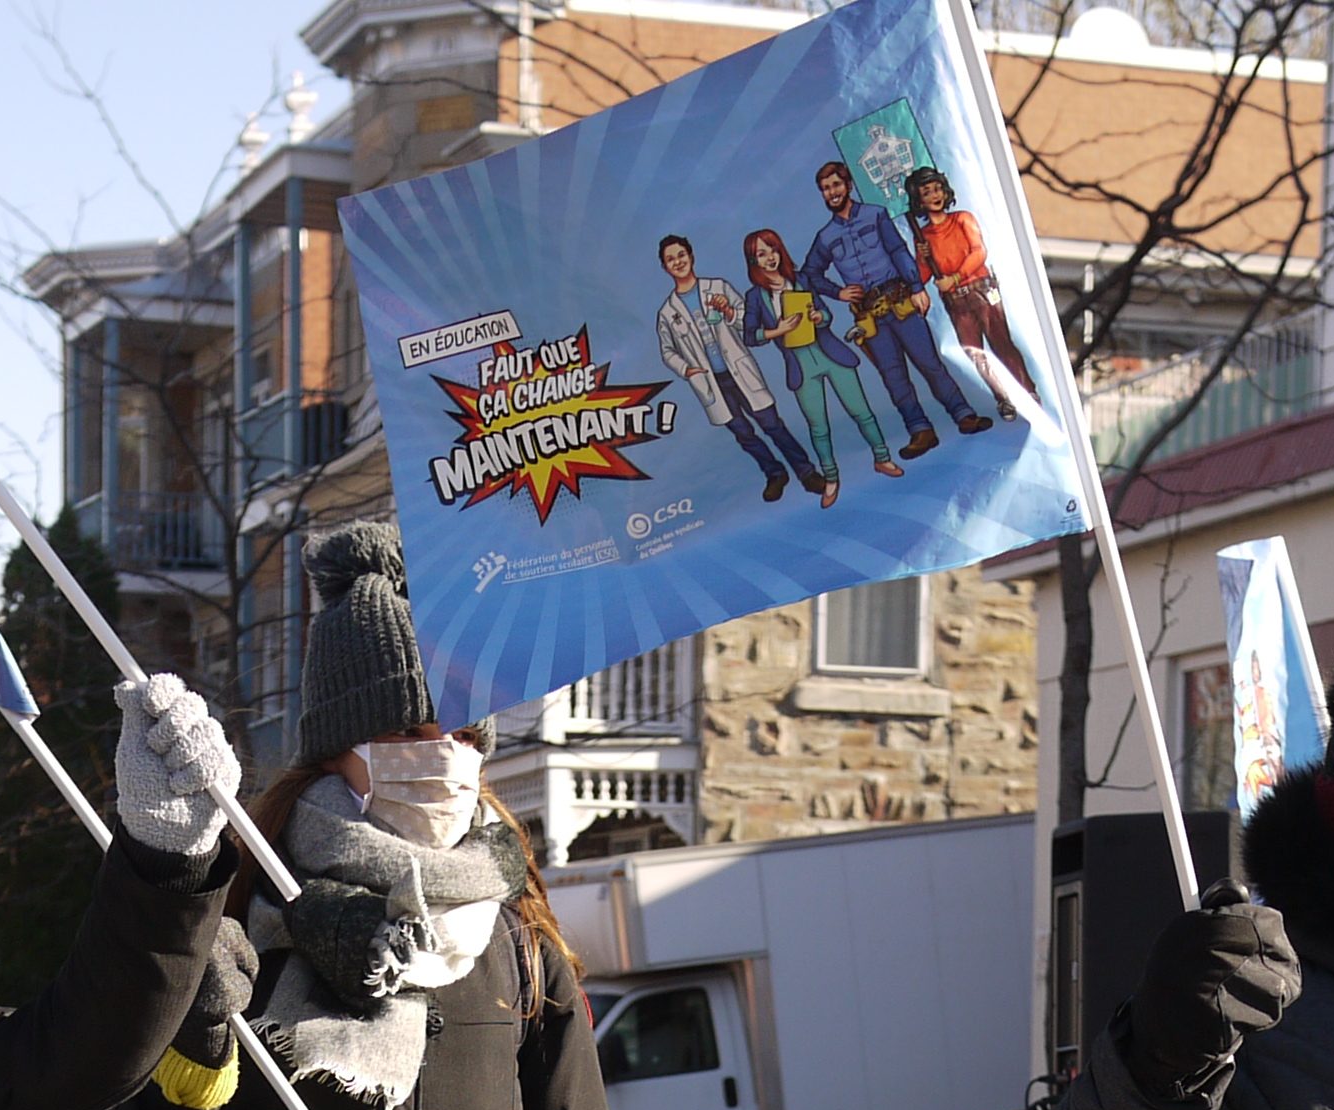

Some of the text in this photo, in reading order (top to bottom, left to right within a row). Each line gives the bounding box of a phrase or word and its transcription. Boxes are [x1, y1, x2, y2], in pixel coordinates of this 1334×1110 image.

[410, 316, 510, 359] EN ÉDUCATION
[479, 336, 582, 387] FAUT QUE
[478, 363, 596, 425] ÇA CHANGE
[654, 498, 694, 524] CSQ
